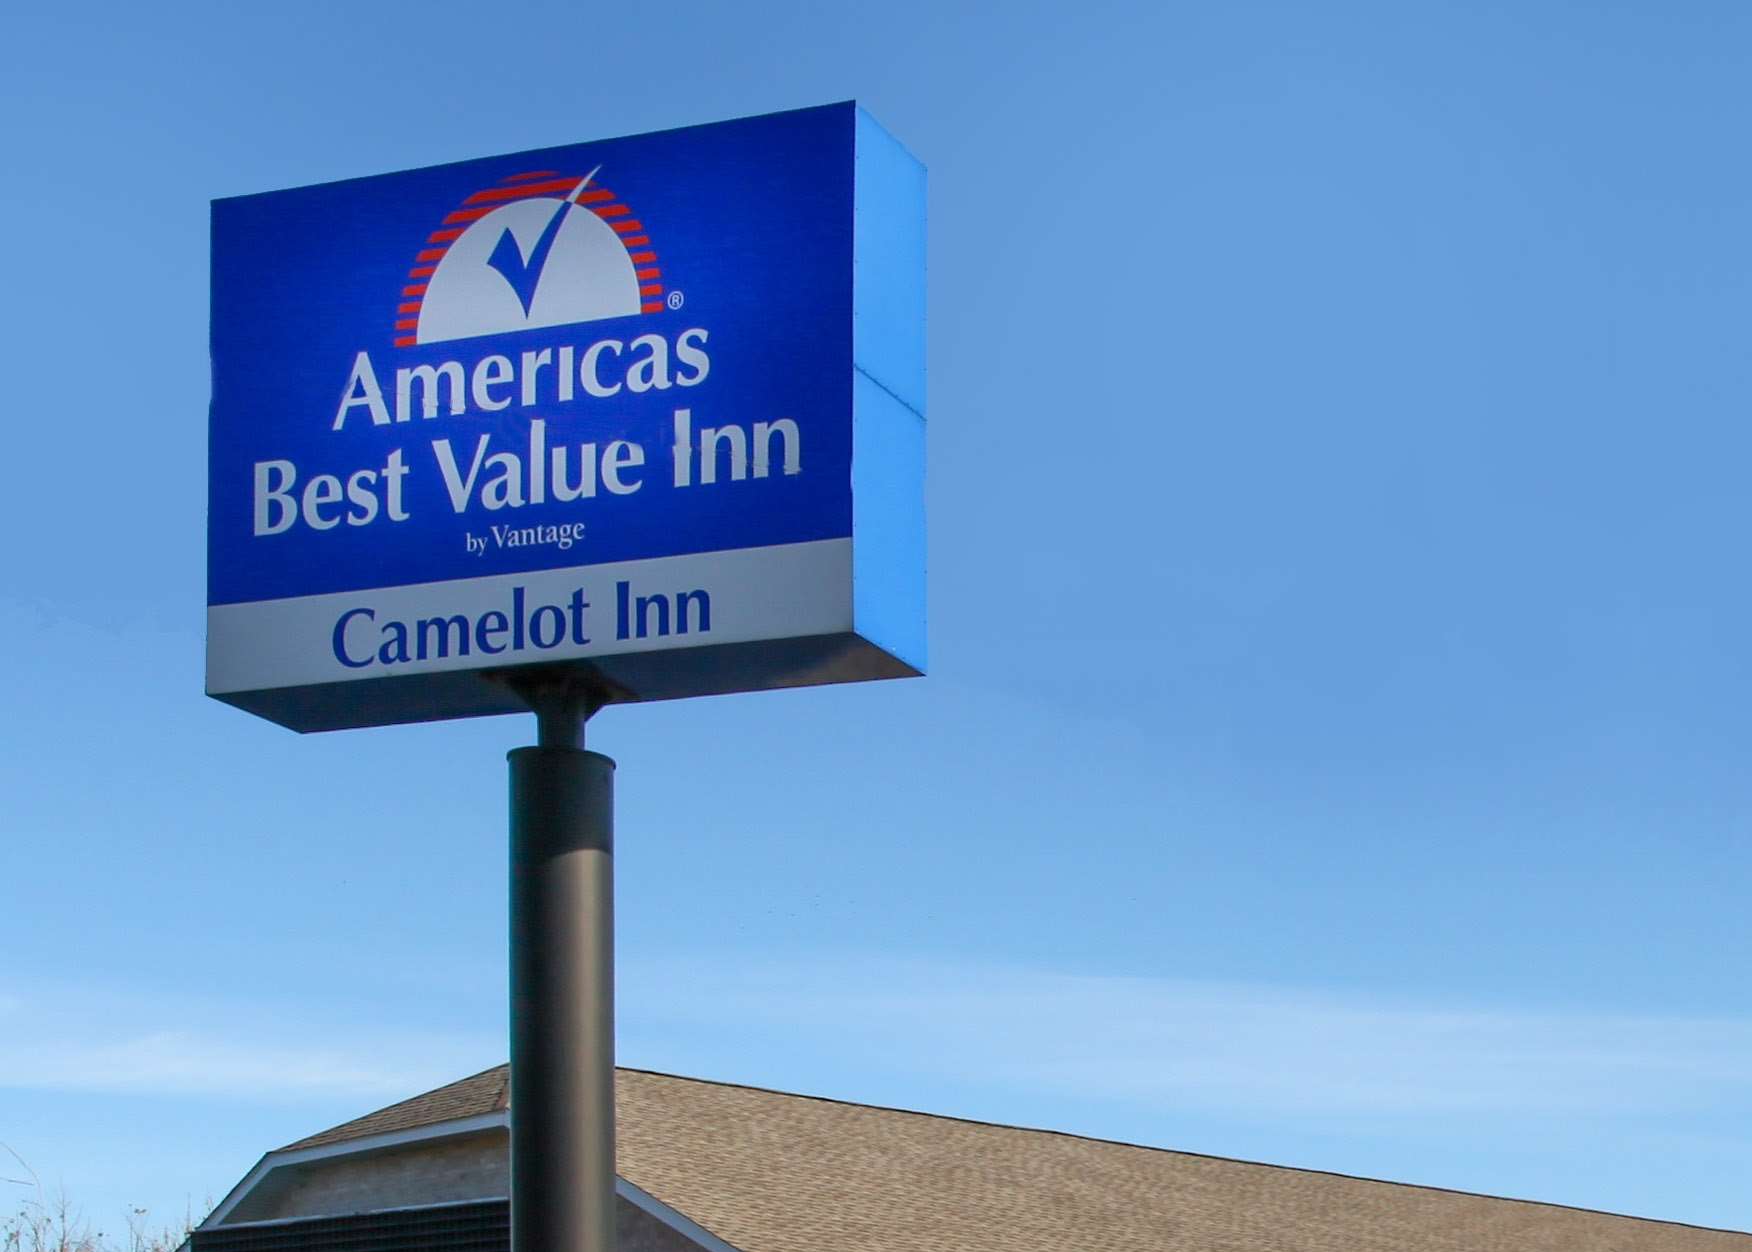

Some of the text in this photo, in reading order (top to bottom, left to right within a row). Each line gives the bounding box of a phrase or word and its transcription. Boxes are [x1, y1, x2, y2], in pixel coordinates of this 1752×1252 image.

[333, 328, 710, 430] Americas
[254, 409, 802, 536] Best Value Inn
[466, 523, 586, 555] by Vantage
[332, 580, 711, 668] Camelot Inn
